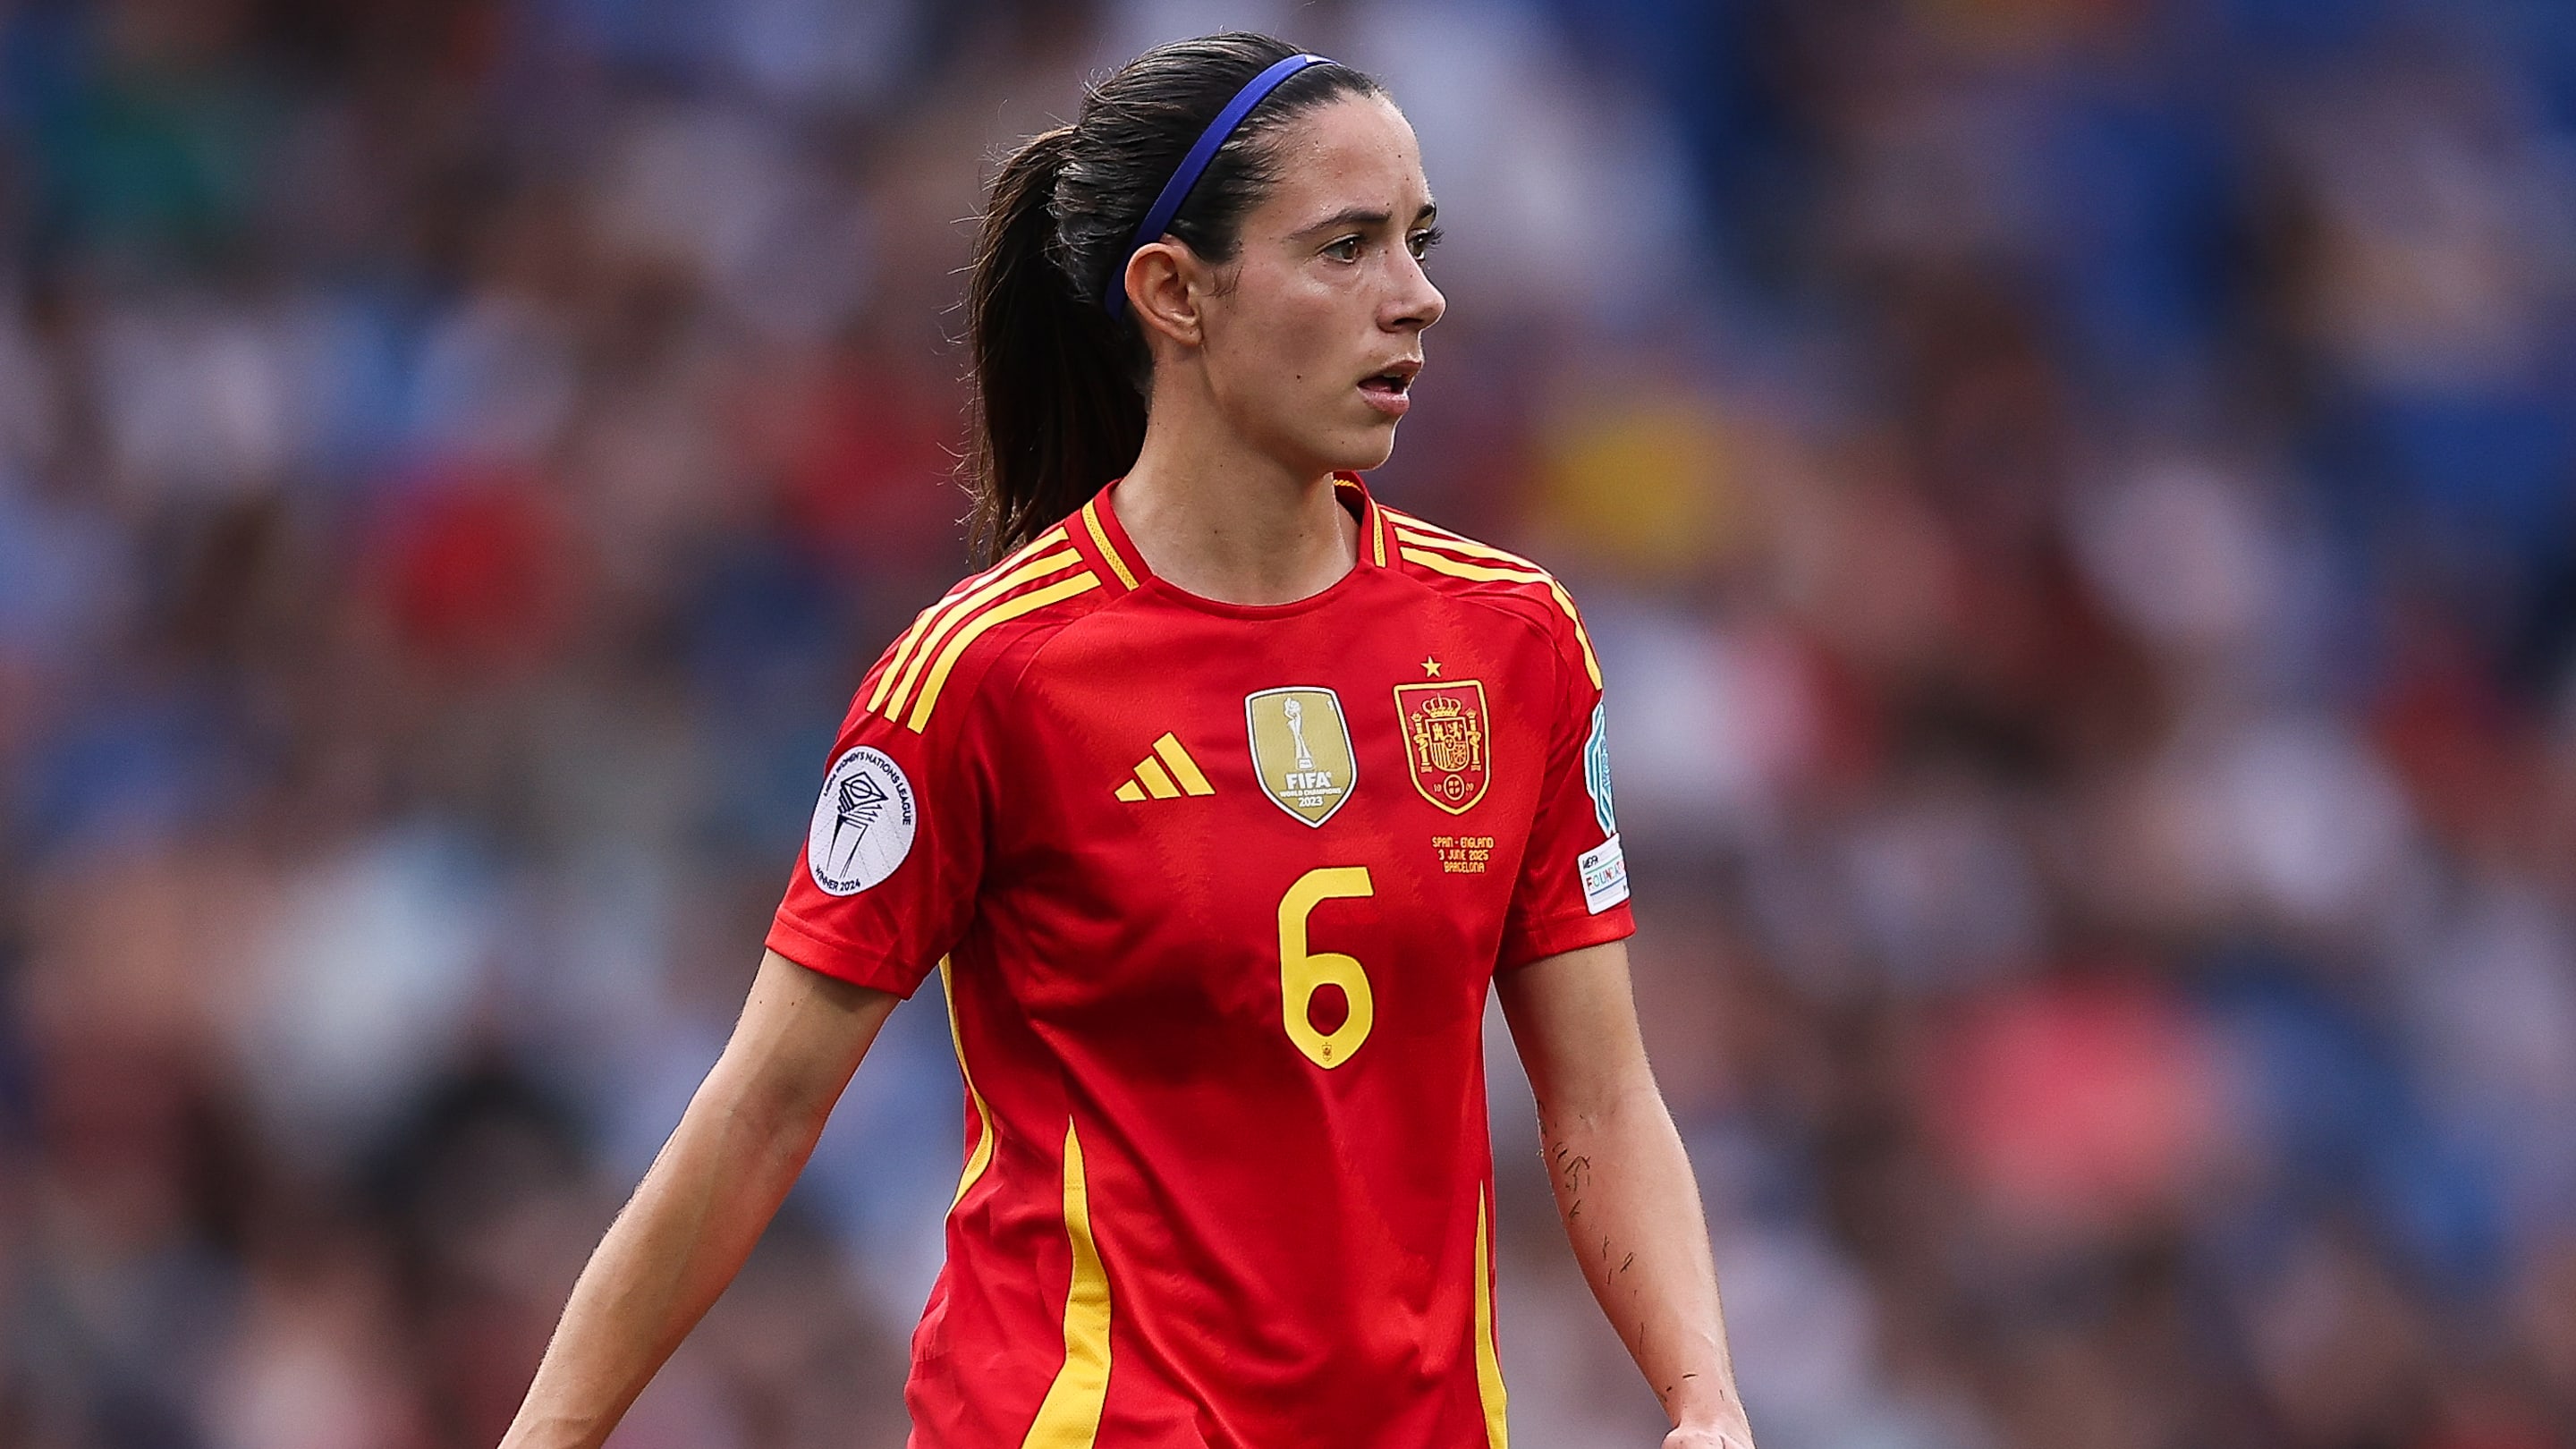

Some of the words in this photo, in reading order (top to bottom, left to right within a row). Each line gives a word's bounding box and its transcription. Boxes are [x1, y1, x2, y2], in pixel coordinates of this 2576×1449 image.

[865, 752, 901, 784] NATIONS
[895, 782, 911, 826] LEAGUE
[1279, 790, 1303, 798] WORLD
[1303, 787, 1342, 796] CHAMPIONS
[1298, 796, 1324, 808] 2023
[1432, 836, 1453, 848] SPAIN
[1460, 836, 1495, 849] ENGLAND
[1437, 848, 1445, 860] 3
[1447, 849, 1467, 860] JUNE
[1468, 849, 1490, 861] 2025
[1444, 860, 1485, 873] BARCELONA
[815, 864, 839, 893] WINNER
[840, 877, 860, 892] 2024
[1278, 867, 1374, 1069] 6
